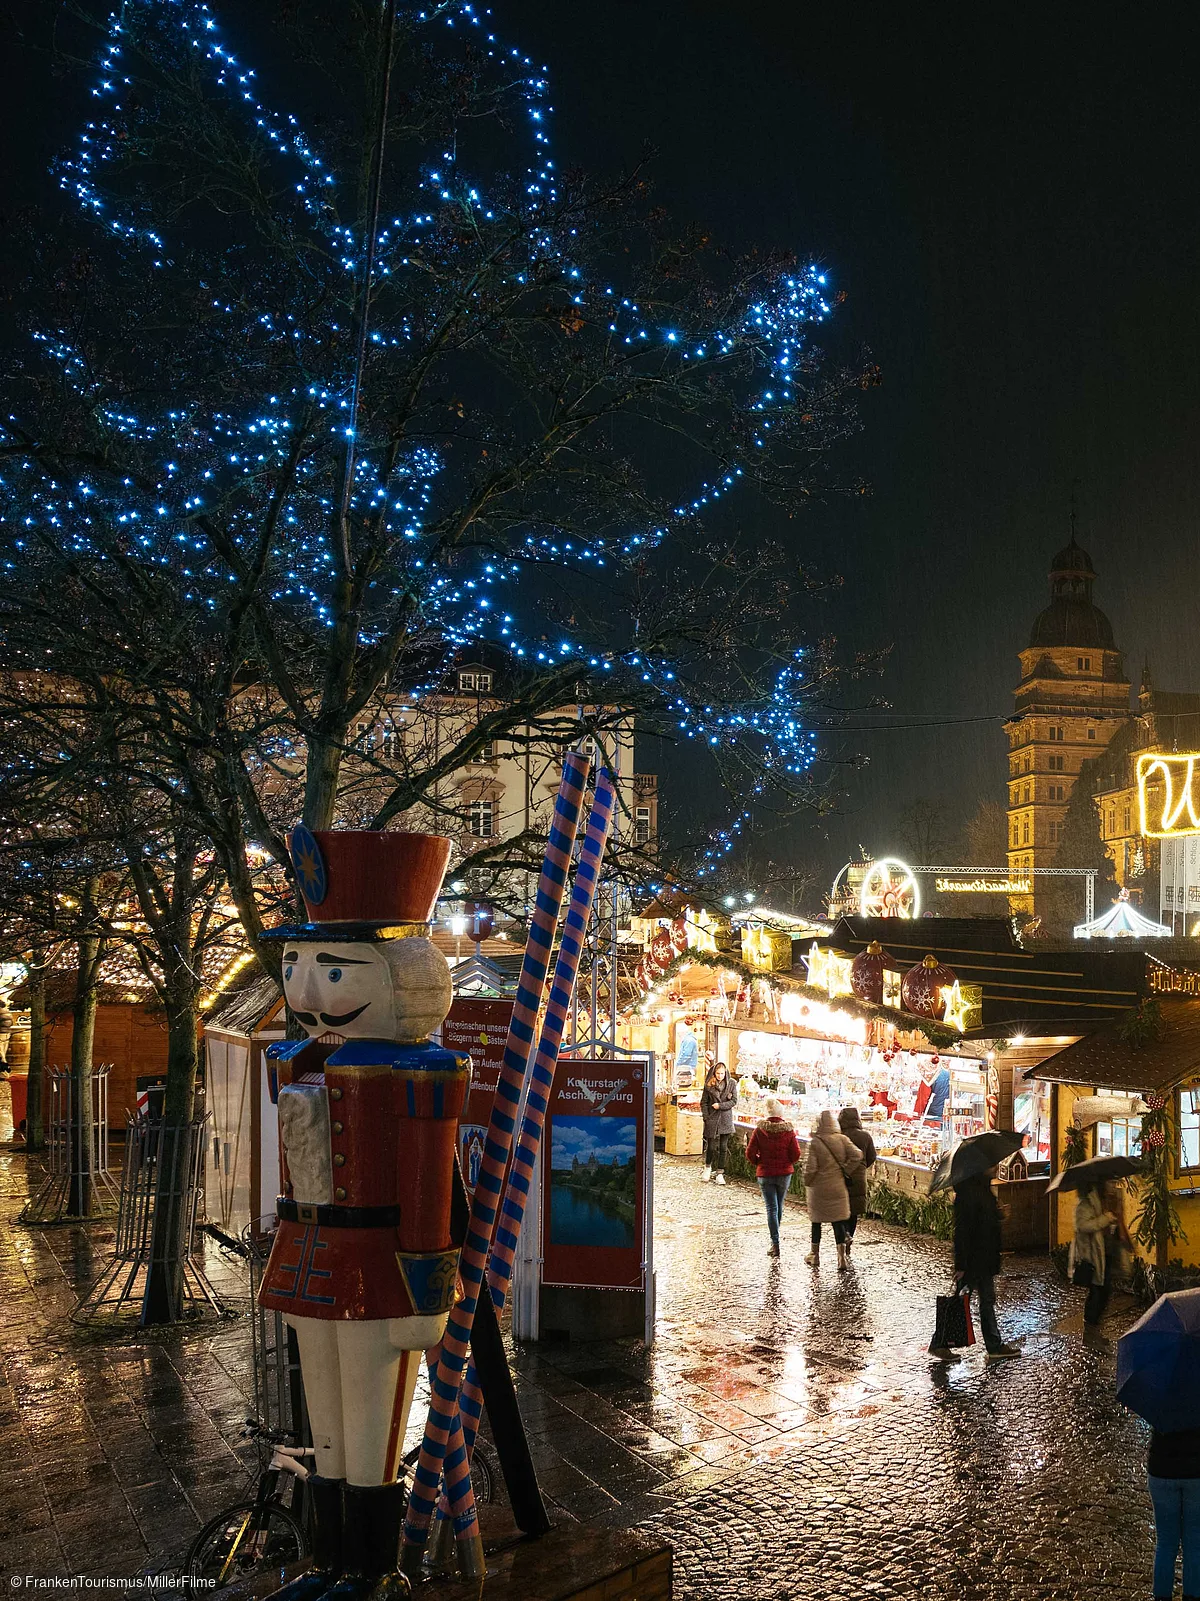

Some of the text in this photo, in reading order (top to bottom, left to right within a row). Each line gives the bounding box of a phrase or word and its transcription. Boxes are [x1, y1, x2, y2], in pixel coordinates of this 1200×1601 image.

[1190, 840, 1198, 865] Schloss
[487, 1023, 509, 1033] unsere
[469, 1045, 486, 1056] einen
[481, 1058, 503, 1069] Aufent
[474, 1069, 481, 1078] in
[470, 1081, 497, 1093] affenbur
[567, 1077, 624, 1088] Kulturstad
